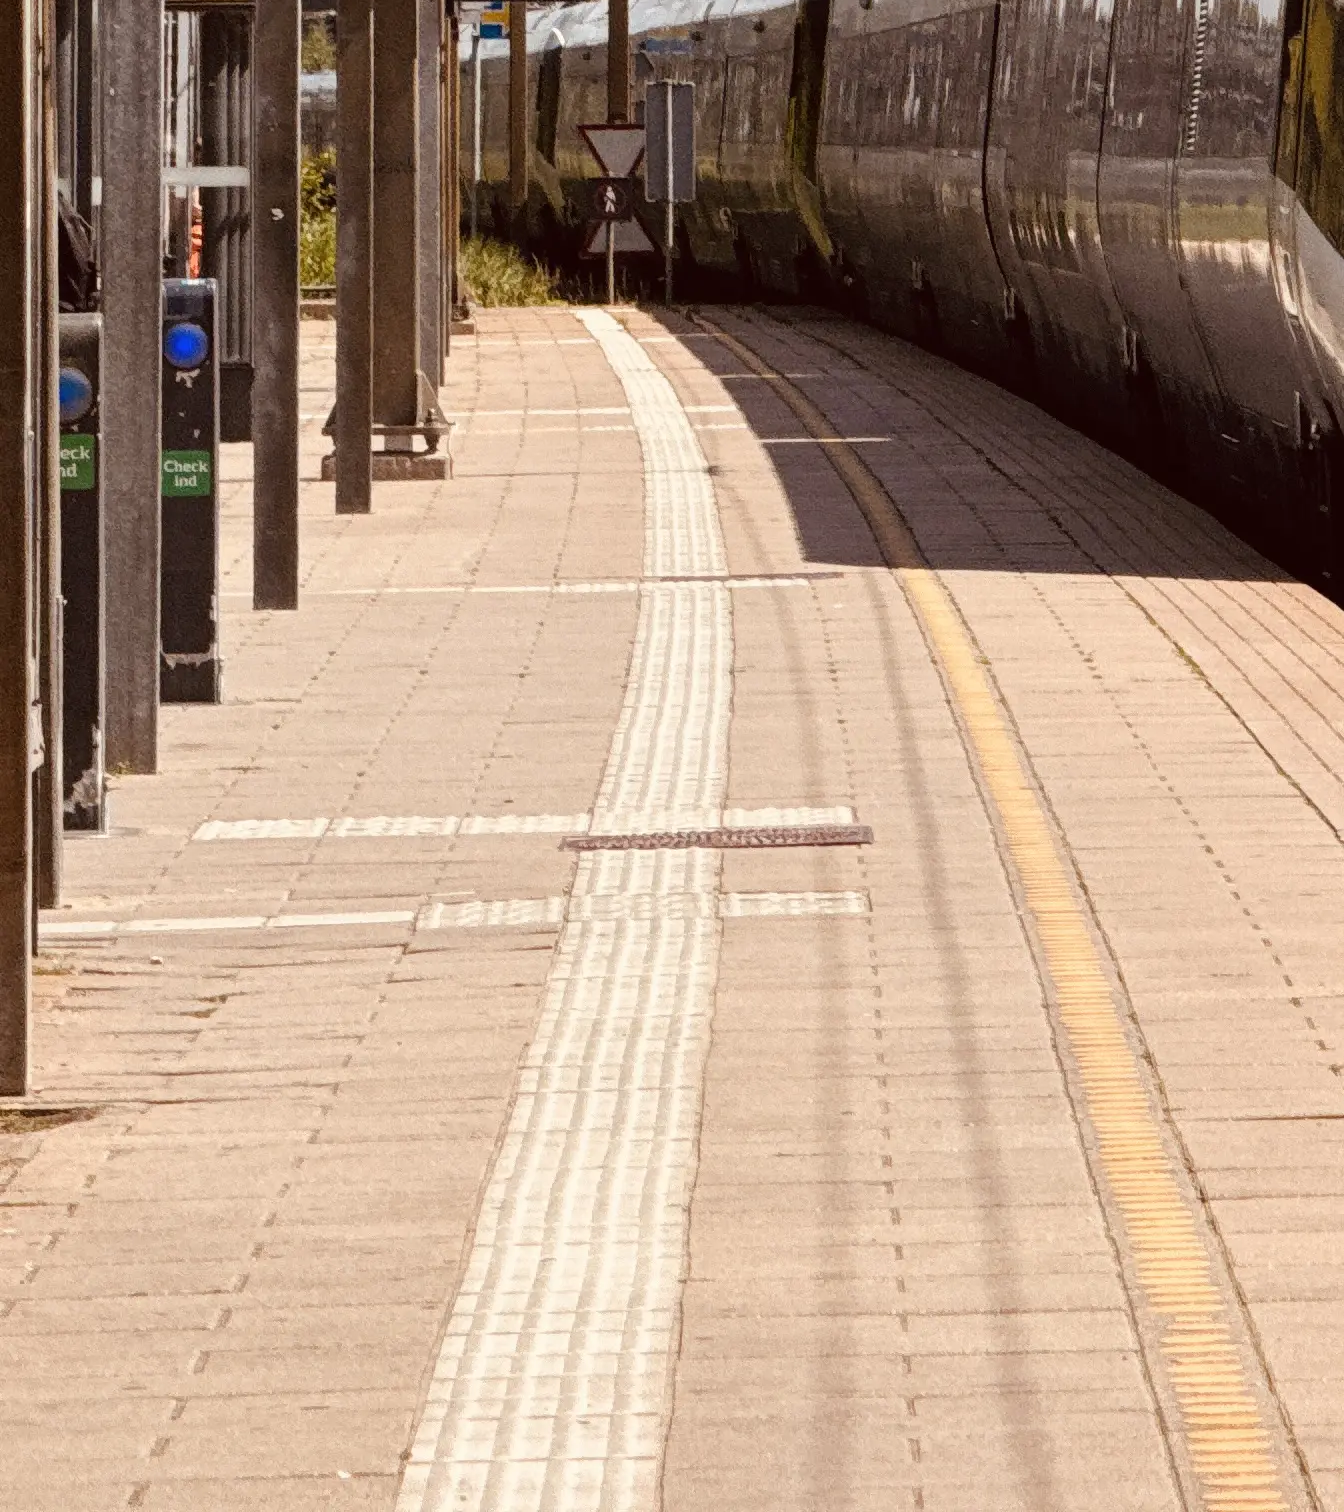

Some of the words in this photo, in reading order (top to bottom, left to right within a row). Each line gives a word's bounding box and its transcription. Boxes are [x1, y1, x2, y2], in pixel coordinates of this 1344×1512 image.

[60, 445, 91, 460] eck
[60, 463, 77, 478] nd
[163, 459, 209, 473] Check
[174, 475, 197, 487] Ind
